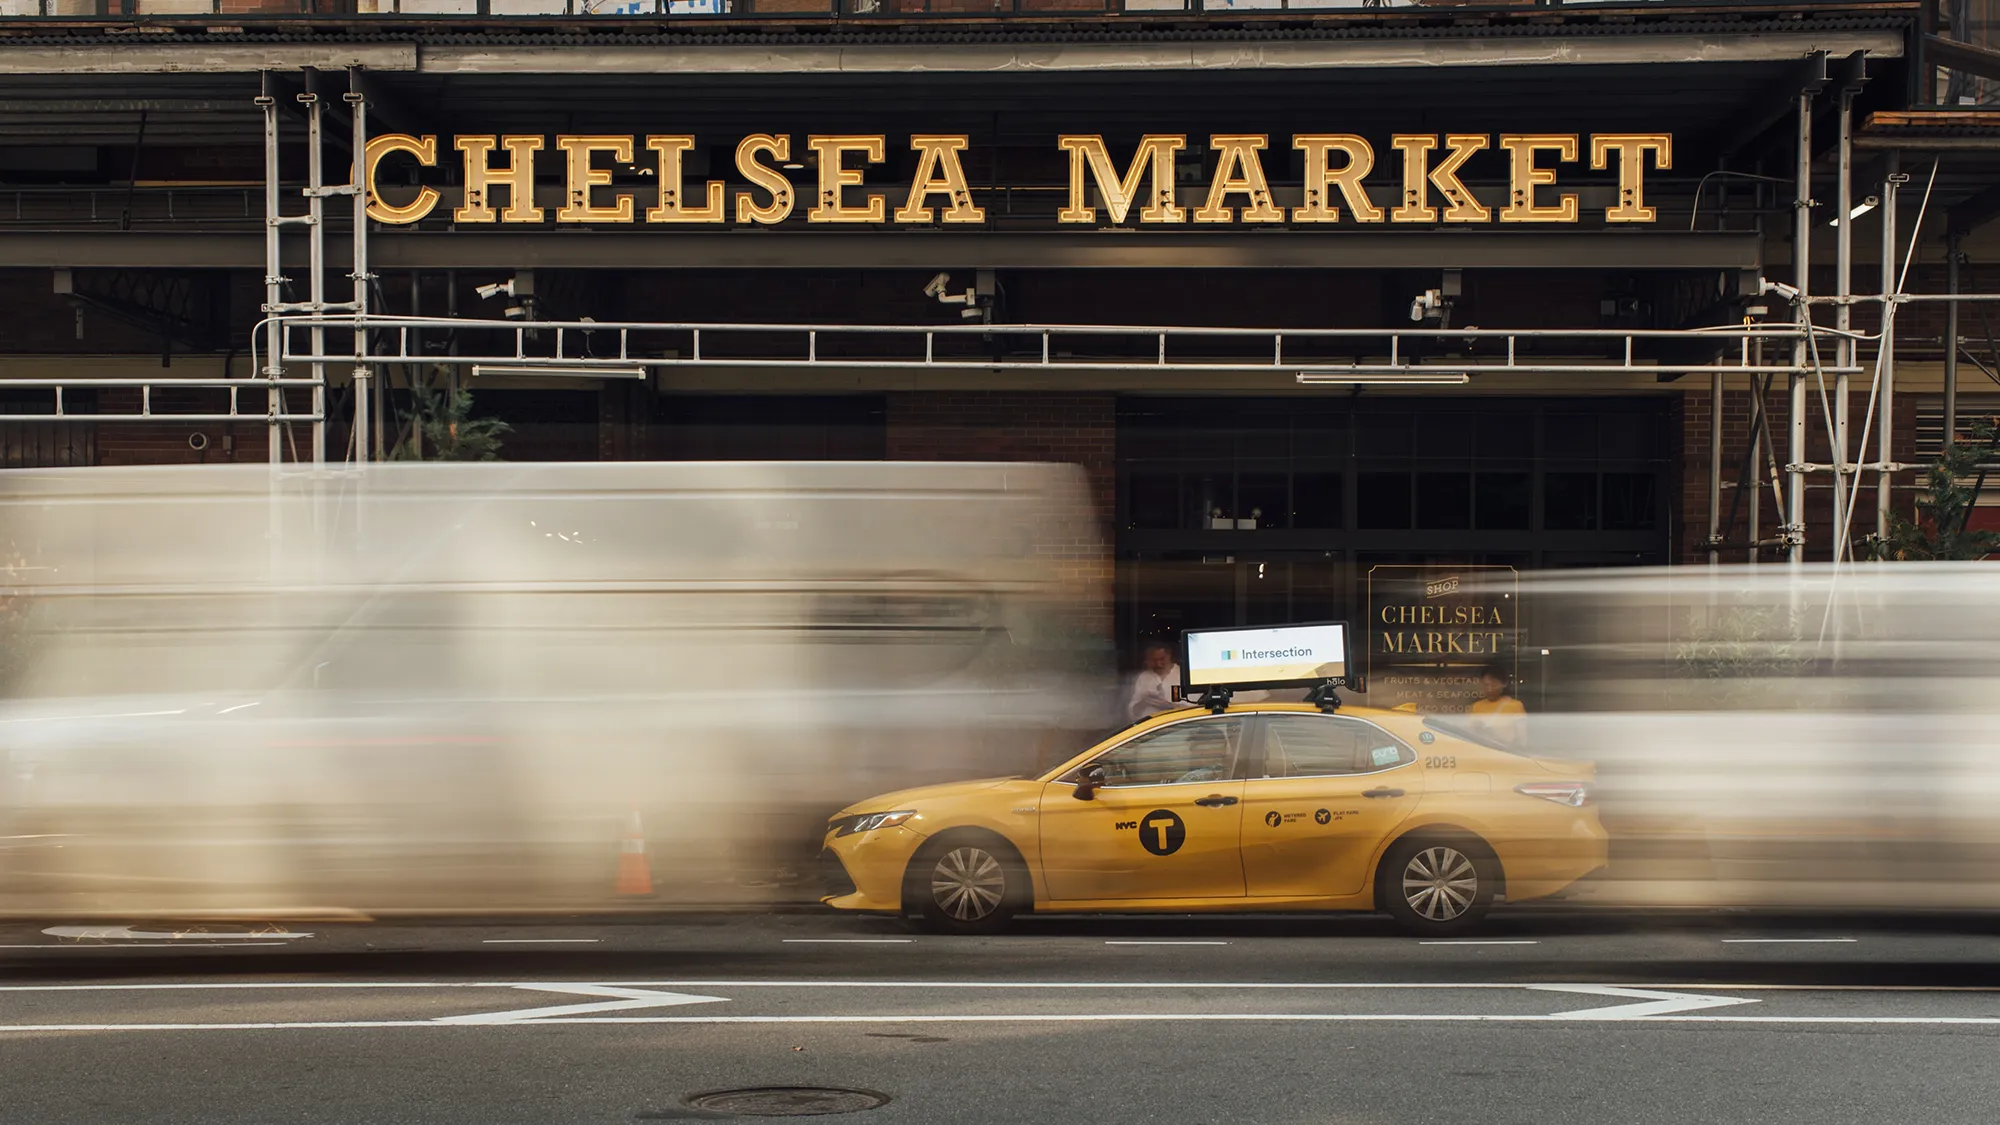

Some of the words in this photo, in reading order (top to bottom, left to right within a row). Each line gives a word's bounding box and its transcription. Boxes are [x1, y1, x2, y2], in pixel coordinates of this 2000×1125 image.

[350, 134, 985, 224] CHELSEA
[1058, 133, 1672, 223] MARKET
[1427, 581, 1459, 595] SHOP
[1381, 605, 1503, 624] CHELSEA
[1382, 632, 1504, 653] MARKET
[1242, 646, 1312, 660] Intersection
[1384, 676, 1420, 685] FRUITS
[1423, 677, 1431, 685] &
[1396, 690, 1424, 699] MEAT
[1442, 704, 1472, 713] GOOD
[1425, 756, 1456, 769] 2023
[1115, 821, 1137, 830] NYC
[1149, 818, 1174, 850] T
